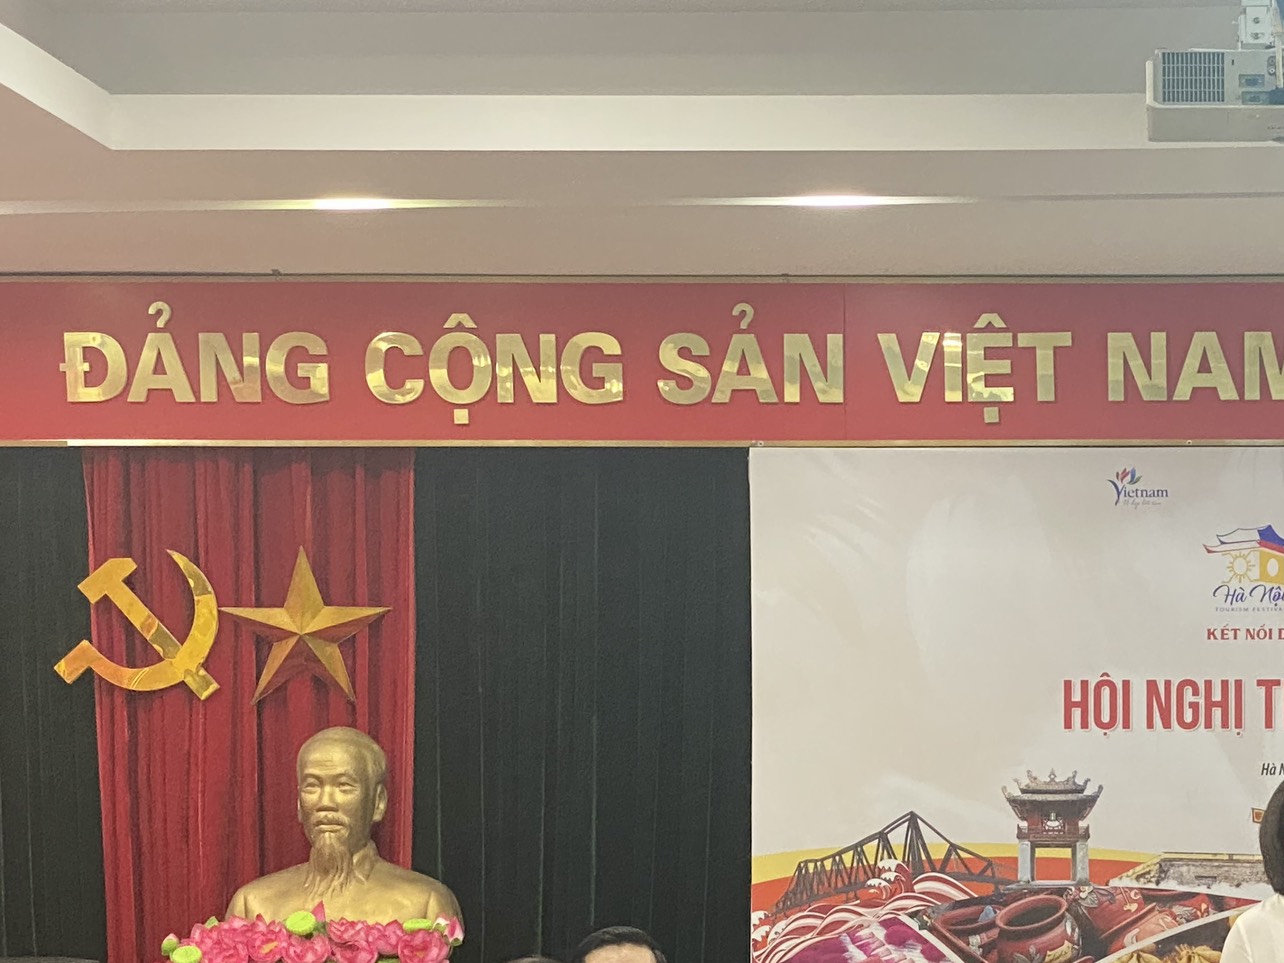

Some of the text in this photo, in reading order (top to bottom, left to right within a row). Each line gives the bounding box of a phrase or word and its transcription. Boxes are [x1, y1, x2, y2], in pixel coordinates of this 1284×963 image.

[60, 301, 330, 403] ĐẢNG
[364, 313, 625, 424] CỘNG
[657, 302, 845, 404] SẢN
[876, 313, 1073, 423] VIỆT
[1106, 479, 1169, 507] Vietnam
[1213, 584, 1247, 605] Hà
[1206, 623, 1241, 640] KẾT
[1245, 623, 1273, 640] NỐI
[1062, 671, 1133, 738] HỘI
[1145, 677, 1244, 738] NGHỊ
[1261, 763, 1277, 776] Hà
